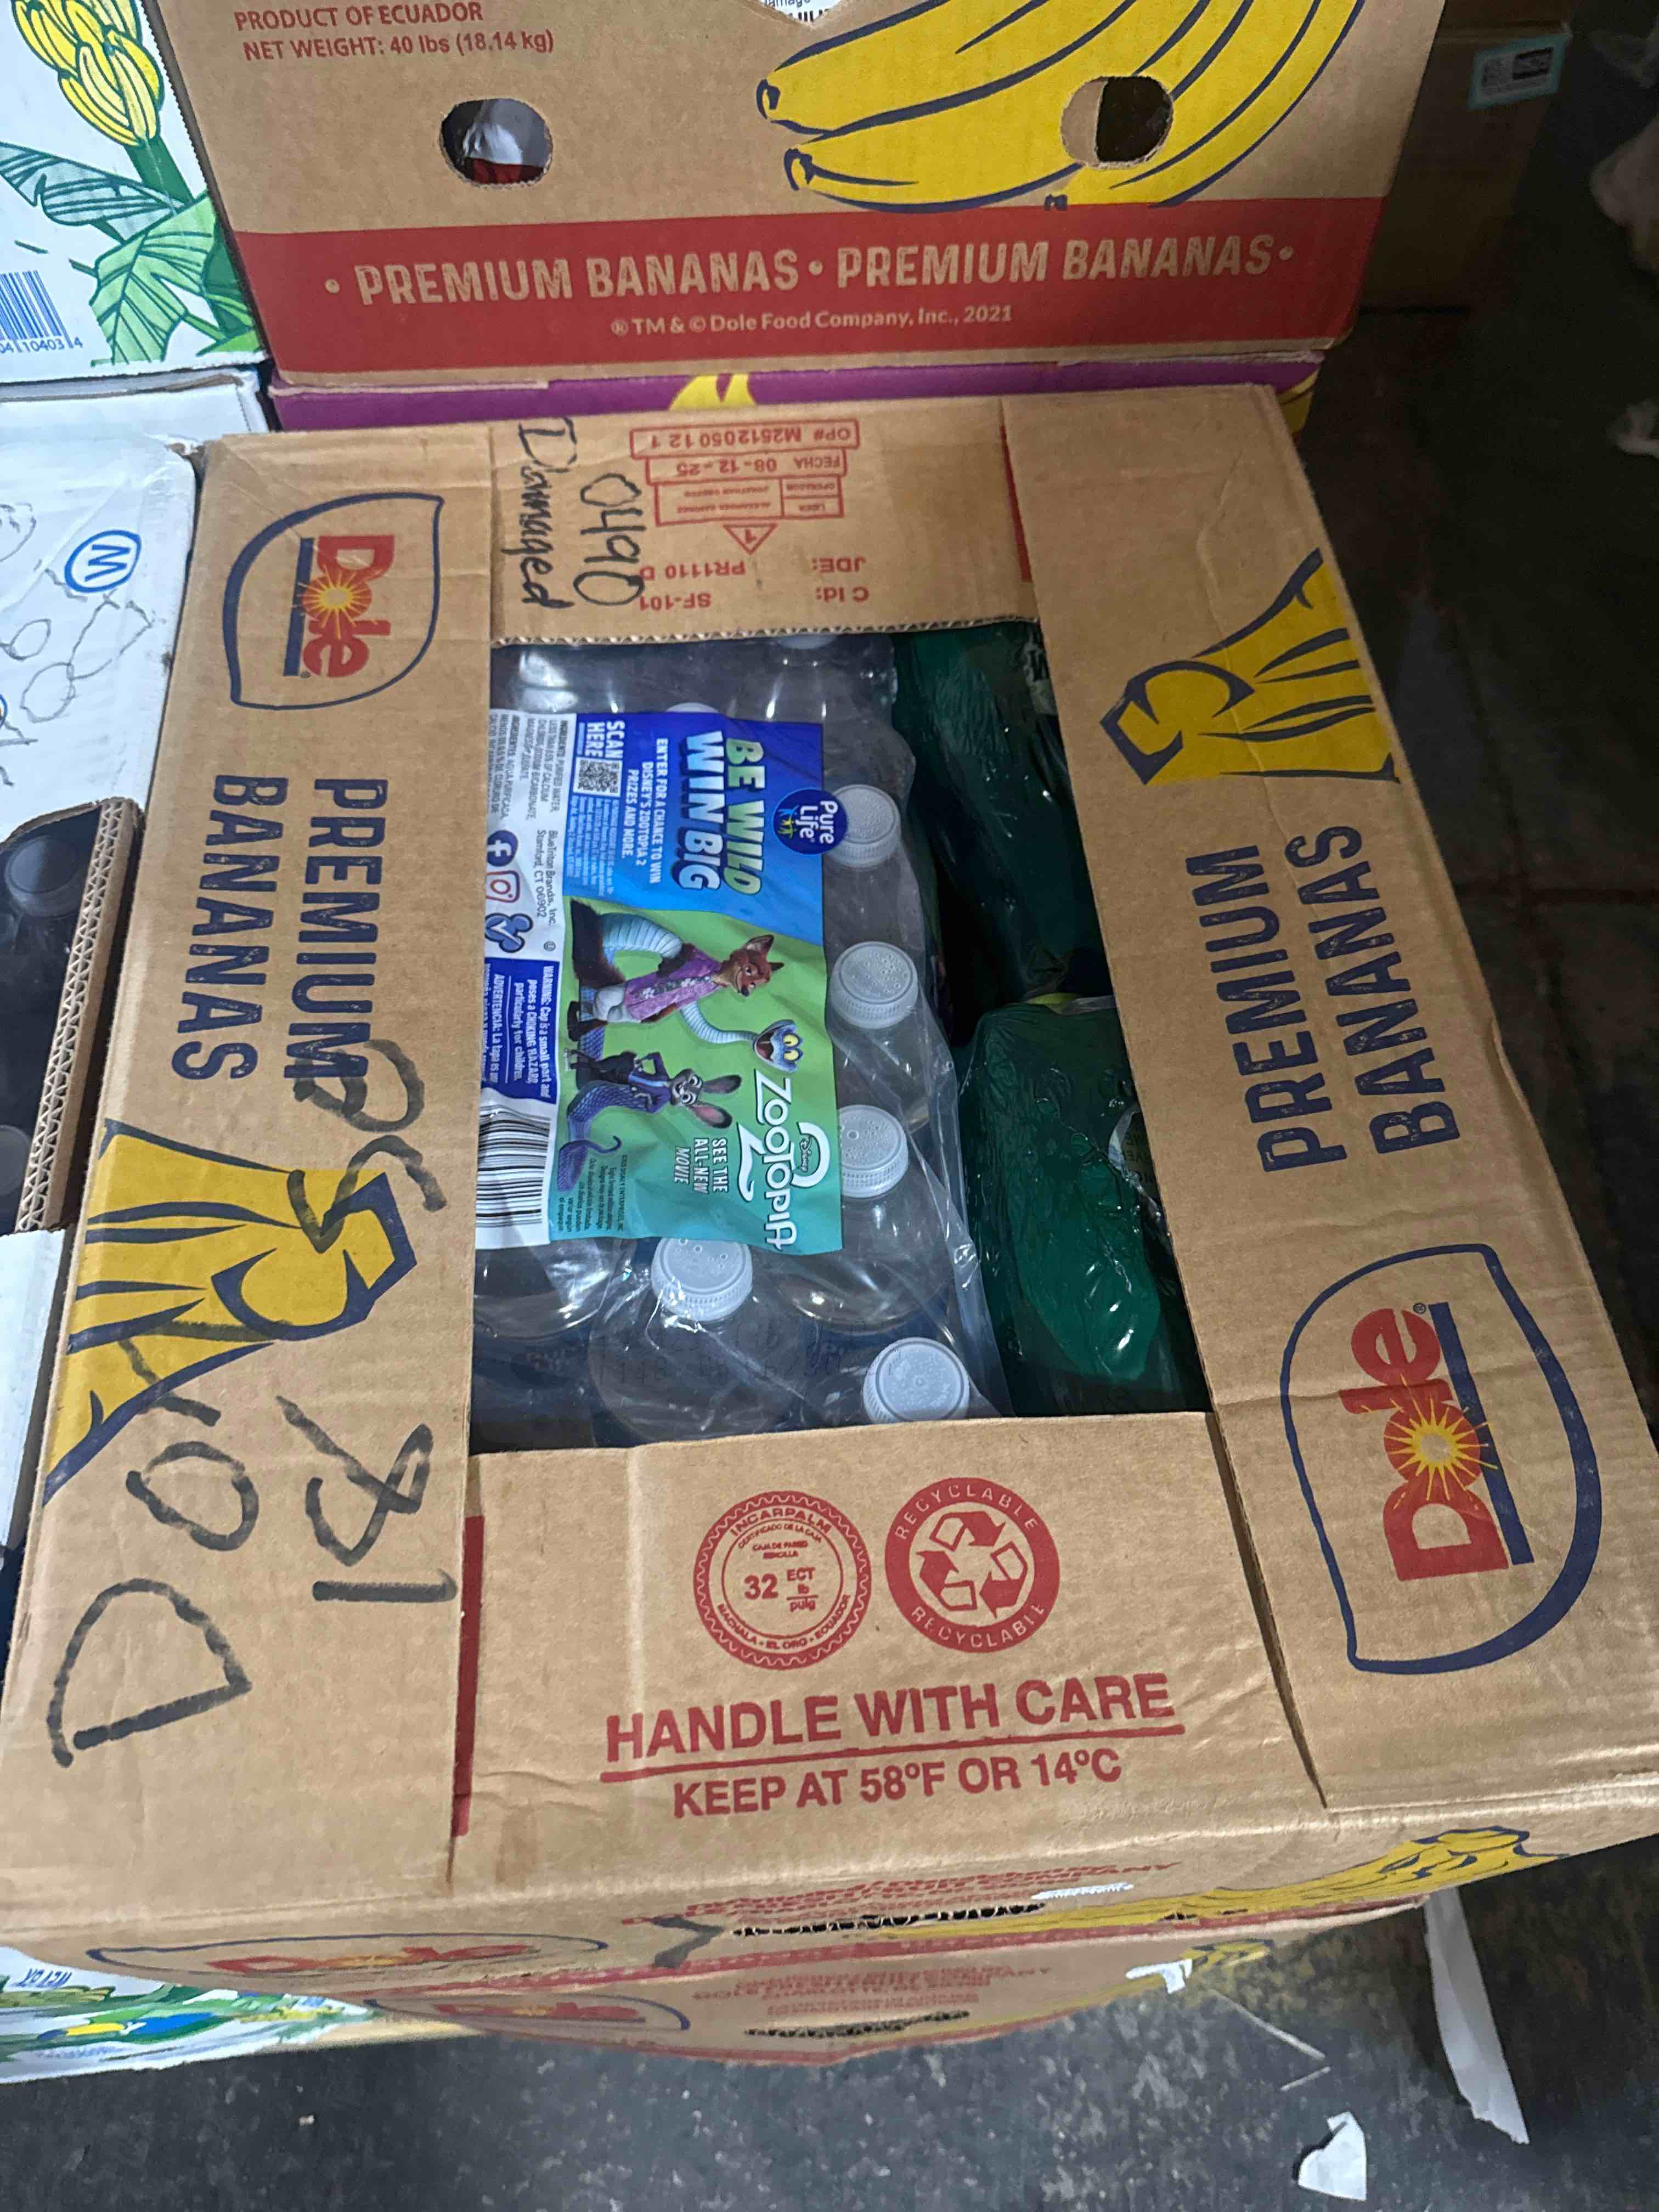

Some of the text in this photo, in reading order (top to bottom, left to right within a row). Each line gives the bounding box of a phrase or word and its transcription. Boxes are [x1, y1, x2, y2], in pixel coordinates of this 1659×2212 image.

[234, 2, 483, 31] PRODUCT OF ECUADOR
[242, 29, 554, 61] NET WEIGHT: 40 lbs (18.14 kg)
[354, 249, 799, 305] PREMIUM BANANAS
[837, 234, 1274, 289] PREMIUM BANANAS
[710, 314, 757, 332] Dole
[761, 312, 811, 330] Food
[815, 309, 913, 330] Company,
[962, 305, 1013, 324] 2021
[793, 456, 841, 469] FECHA
[665, 561, 746, 580] PR1110
[812, 556, 867, 573] JDE:
[302, 535, 395, 678] Dole
[639, 591, 712, 611] SF-101
[852, 586, 870, 603] C
[584, 722, 606, 757] HERE
[605, 720, 625, 759] SCAN
[655, 738, 669, 776] ENTER
[655, 778, 668, 800] FOR
[621, 769, 640, 860] PRIZES AND MORE.
[636, 761, 654, 866] DISNEY'S ZOOTOPIA 2
[652, 808, 667, 845] CHANCE
[678, 730, 725, 890] WIN BIG
[724, 737, 766, 895] BE WILD
[819, 800, 839, 844] Pure
[534, 829, 548, 918] Stamford, CT 06902
[650, 862, 662, 884] WIN
[651, 847, 663, 861] TO
[545, 830, 558, 927] BlueTriton Brands, Inc.
[171, 774, 289, 1080] BANANAS
[284, 778, 388, 1079] PREMIUM
[492, 974, 505, 1032] ADVERTENCIA:
[511, 982, 525, 1029] particularly
[527, 979, 538, 1003] poses
[540, 966, 554, 1006] WARNING:
[1283, 825, 1460, 1155] BANANAS
[538, 1007, 551, 1021] Cap
[1184, 845, 1347, 1172] PREMIUM
[492, 1032, 503, 1043] La
[514, 1030, 523, 1045] for
[526, 1011, 538, 1047] CHOKING
[539, 1036, 551, 1062] small
[540, 1062, 552, 1082] part
[674, 1147, 690, 1184] MOVIE
[693, 1138, 709, 1194] ALL-NEW
[712, 1138, 729, 1192] SEE THE
[754, 1069, 797, 1251] ZOOTOPIA
[1338, 1307, 1509, 1582] Dole
[730, 1508, 834, 1537] INCARPALM
[795, 1525, 804, 1533] LA
[894, 1484, 1039, 1541] RECYCLABLE
[744, 1566, 816, 1600] 32 ECT
[717, 1594, 851, 1650] MACHALA EL ORO ECUADOR
[606, 1672, 1176, 1763] HANDLE WITH CARE
[673, 1775, 787, 1819] KEEP
[796, 1768, 849, 1808] AT
[958, 1756, 1022, 1794] OR
